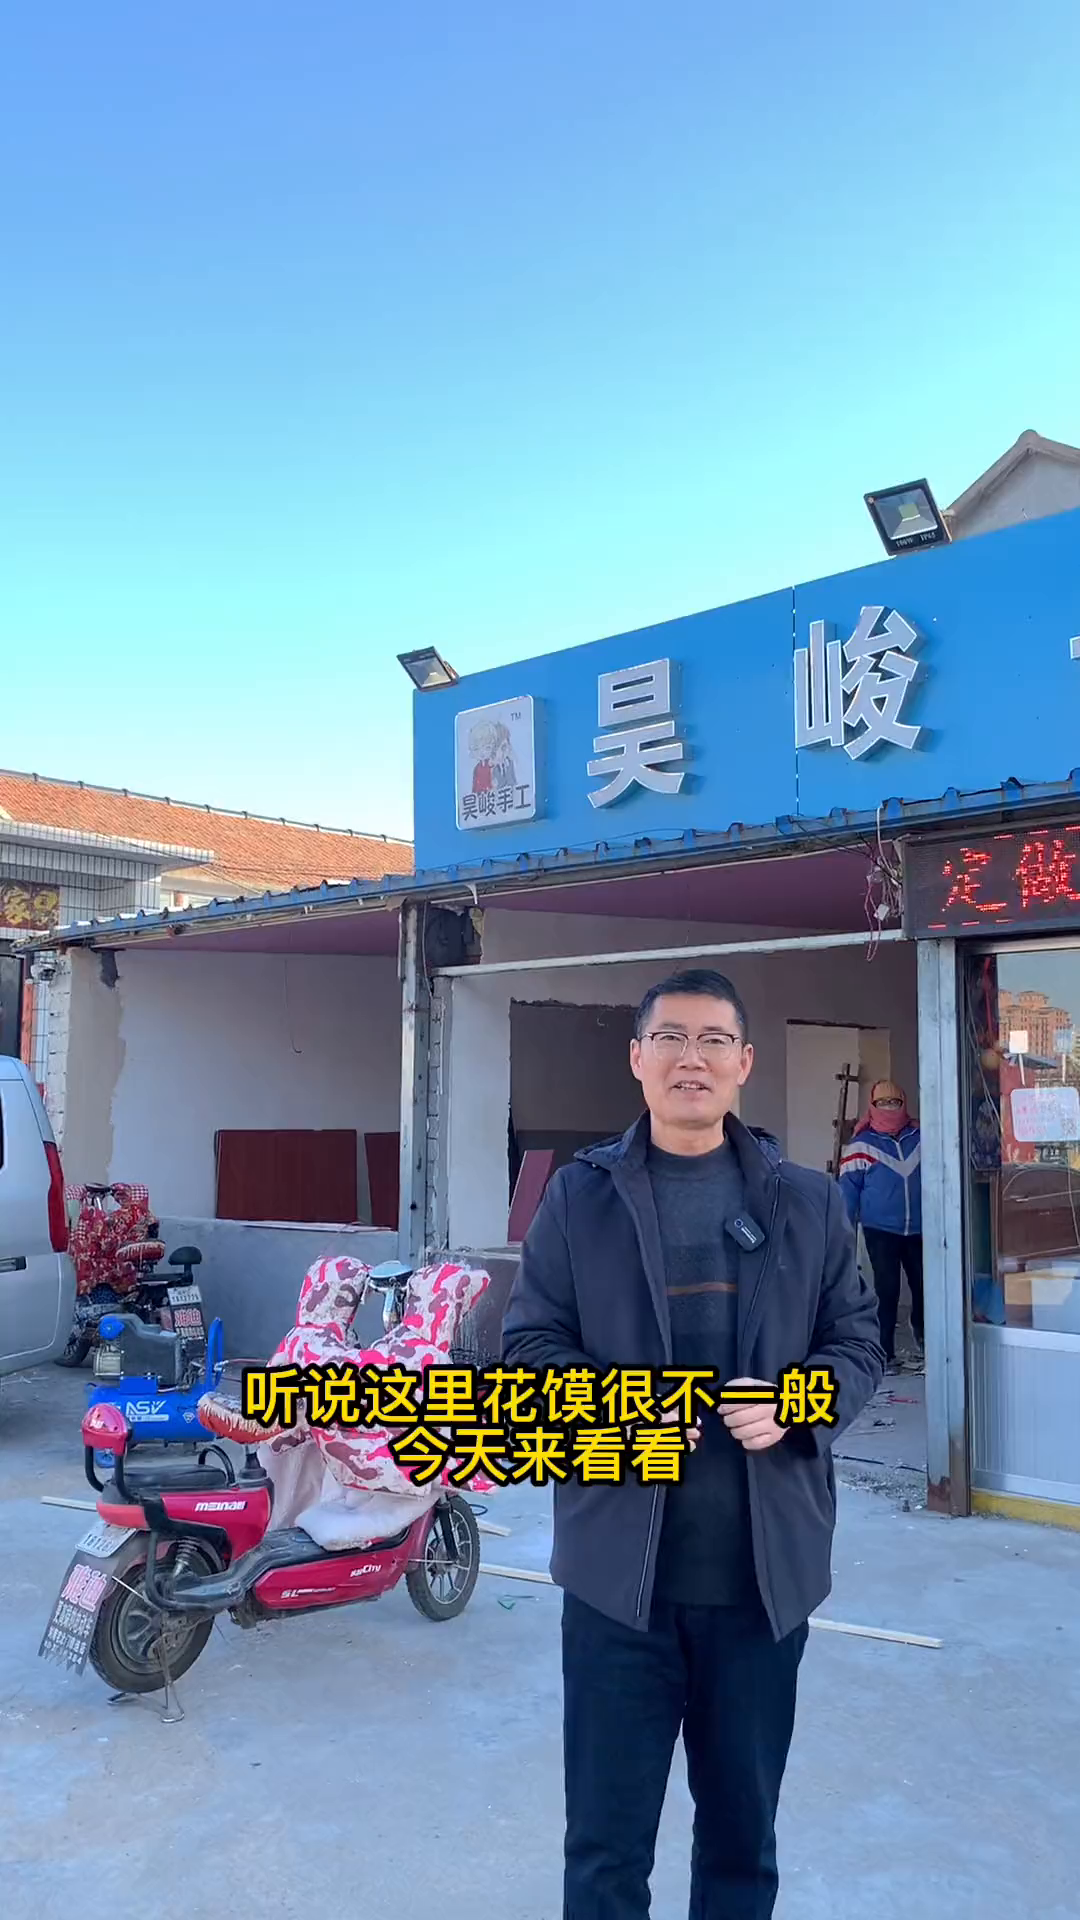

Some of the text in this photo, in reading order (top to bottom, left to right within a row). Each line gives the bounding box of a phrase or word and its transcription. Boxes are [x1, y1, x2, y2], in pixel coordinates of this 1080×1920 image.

[510, 711, 521, 721] TM
[461, 784, 532, 821] 昊峻手工
